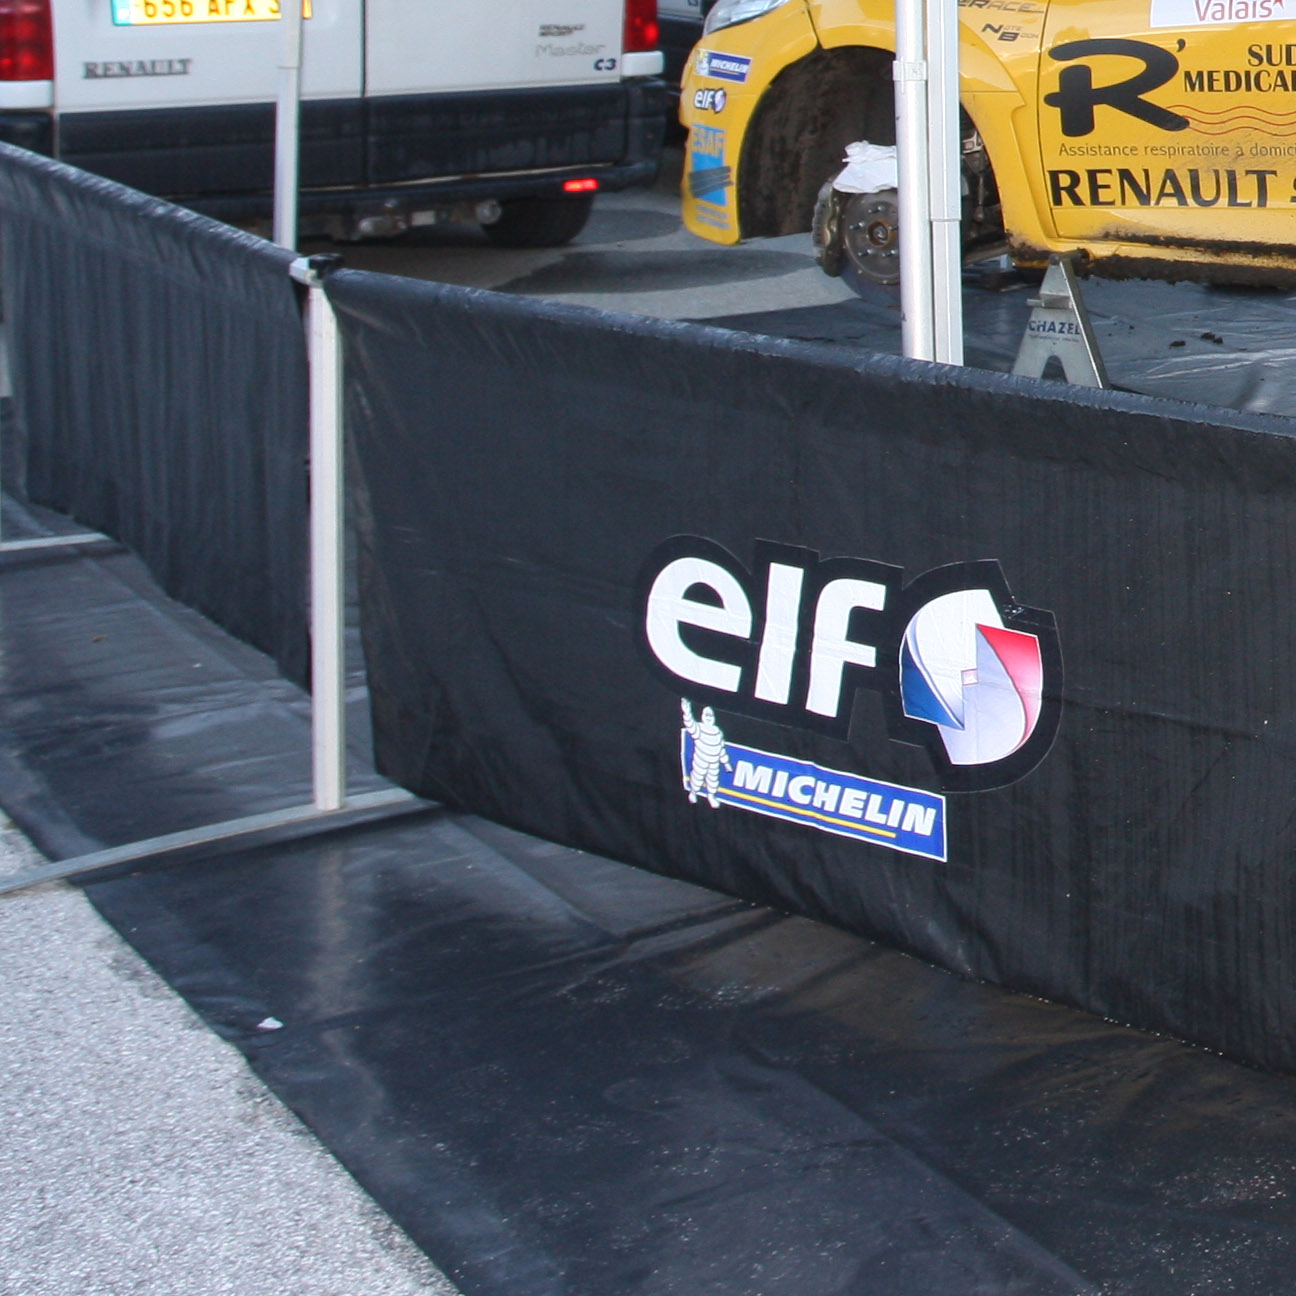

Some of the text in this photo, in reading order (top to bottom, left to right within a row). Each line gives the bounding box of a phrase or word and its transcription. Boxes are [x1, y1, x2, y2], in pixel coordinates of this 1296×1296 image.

[82, 59, 192, 79] RENAULT
[593, 57, 617, 72] C3
[694, 89, 714, 109] elf
[1058, 142, 1139, 157] Assistance
[1144, 142, 1231, 161] respiratoire
[1235, 143, 1245, 157] à
[1046, 168, 1277, 208] RENAULT
[1028, 319, 1081, 336] CHAZEL
[646, 556, 887, 718] elf
[733, 761, 936, 836] MICHELIN
